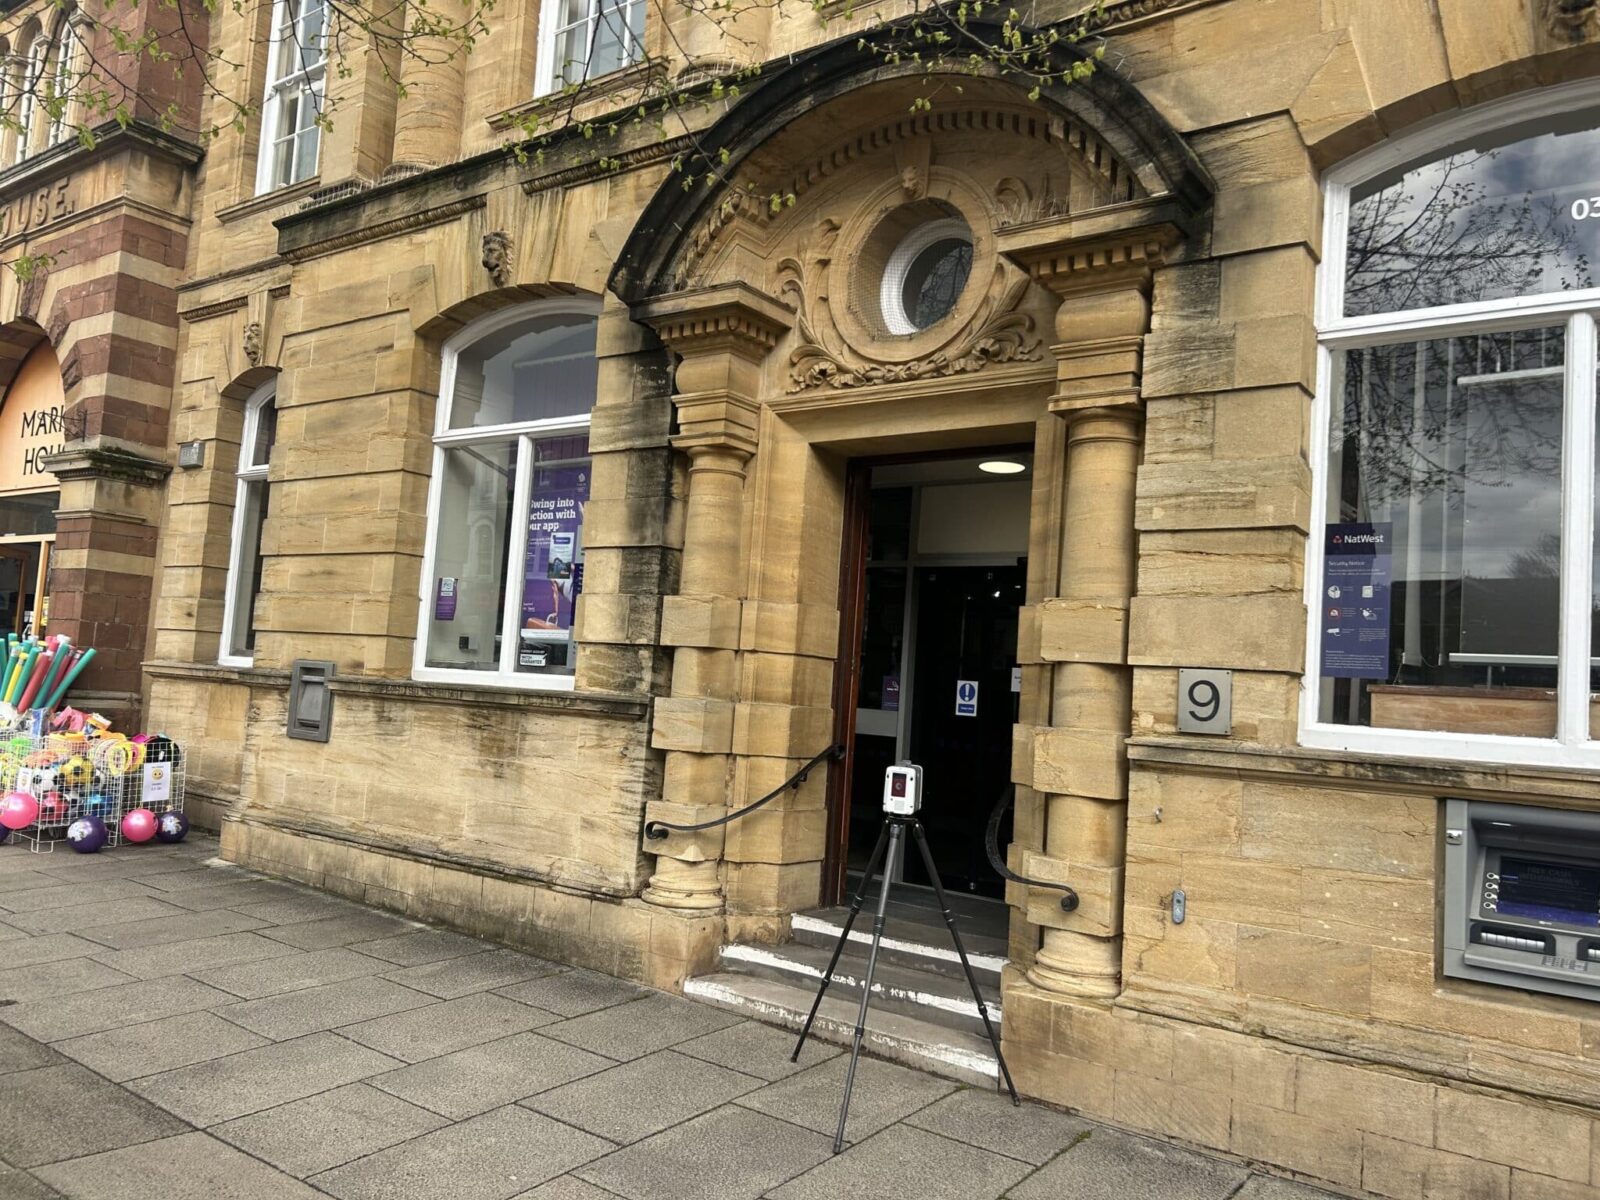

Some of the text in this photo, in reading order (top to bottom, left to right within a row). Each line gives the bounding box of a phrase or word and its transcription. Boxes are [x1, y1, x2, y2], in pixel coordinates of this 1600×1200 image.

[1571, 196, 1600, 221] 03
[557, 497, 574, 508] into
[556, 509, 576, 519] with
[529, 522, 559, 532] ur app
[1344, 534, 1384, 543] NatWest
[1188, 680, 1220, 722] 9
